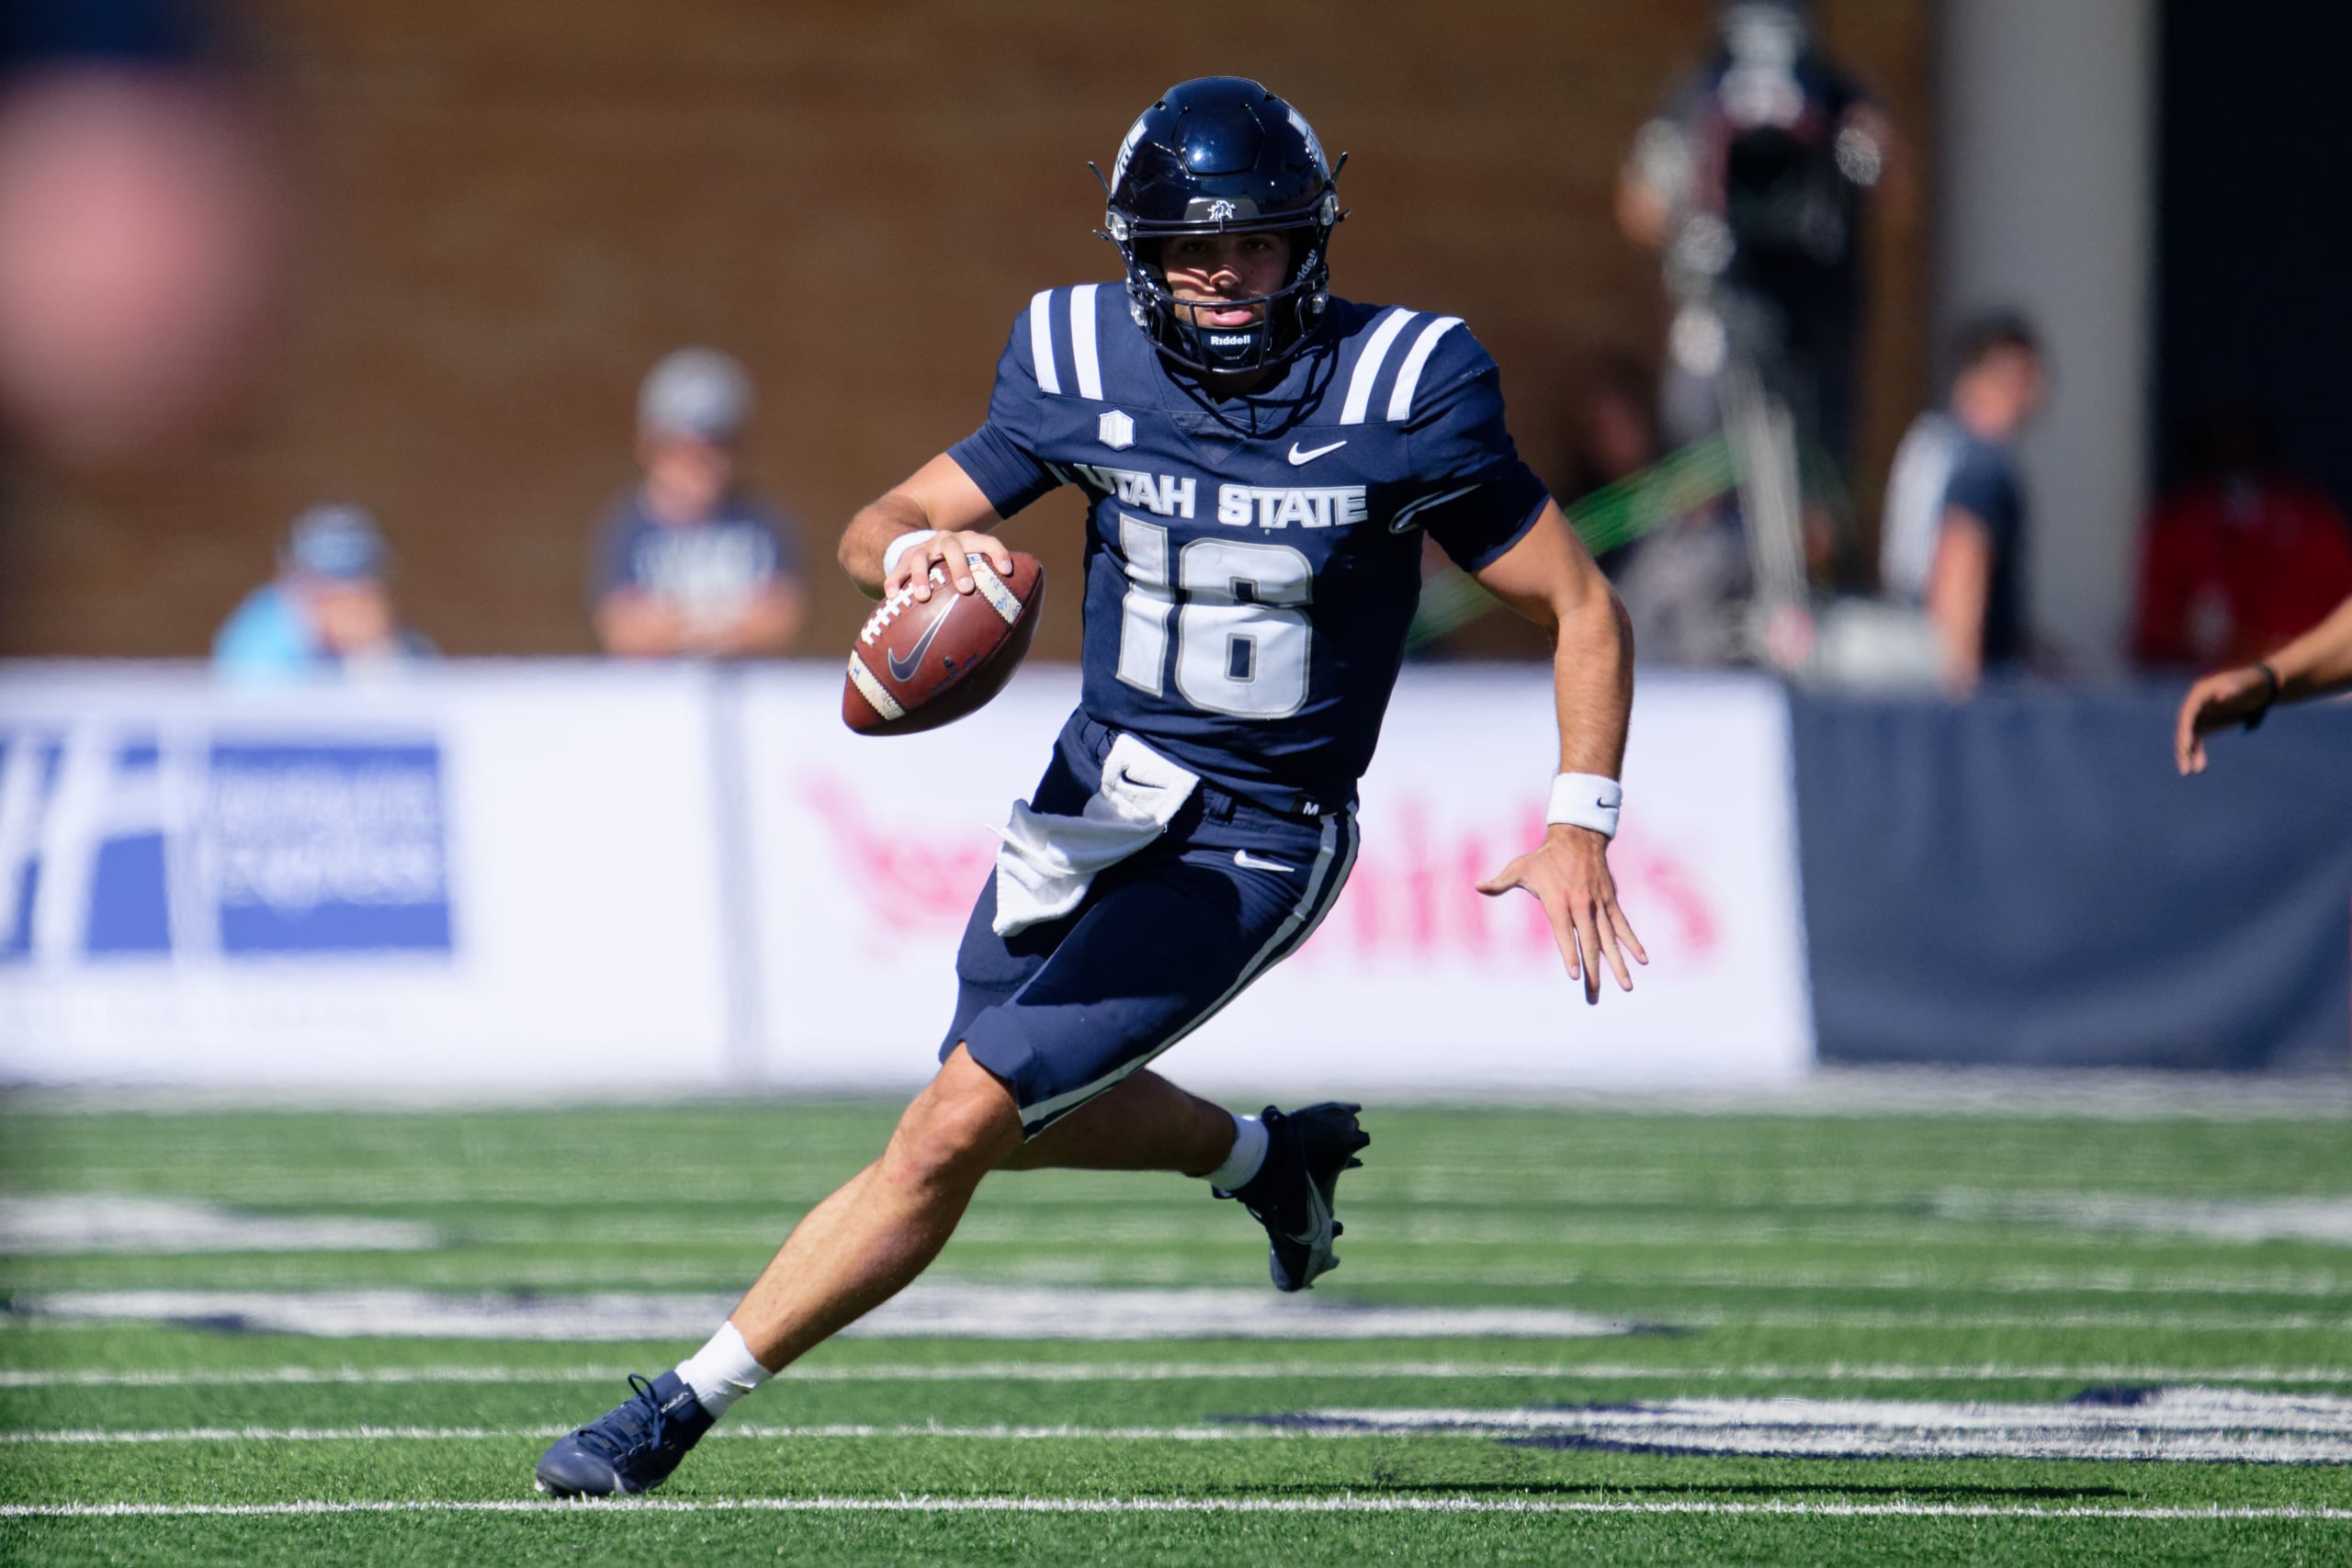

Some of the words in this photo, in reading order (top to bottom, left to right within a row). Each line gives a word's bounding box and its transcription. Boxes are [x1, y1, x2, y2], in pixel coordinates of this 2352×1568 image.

[1210, 334, 1250, 345] Riddell
[1073, 463, 1196, 519] UTAH
[1217, 484, 1368, 529] STATE
[1115, 513, 1314, 719] 16
[1303, 801, 1320, 816] M
